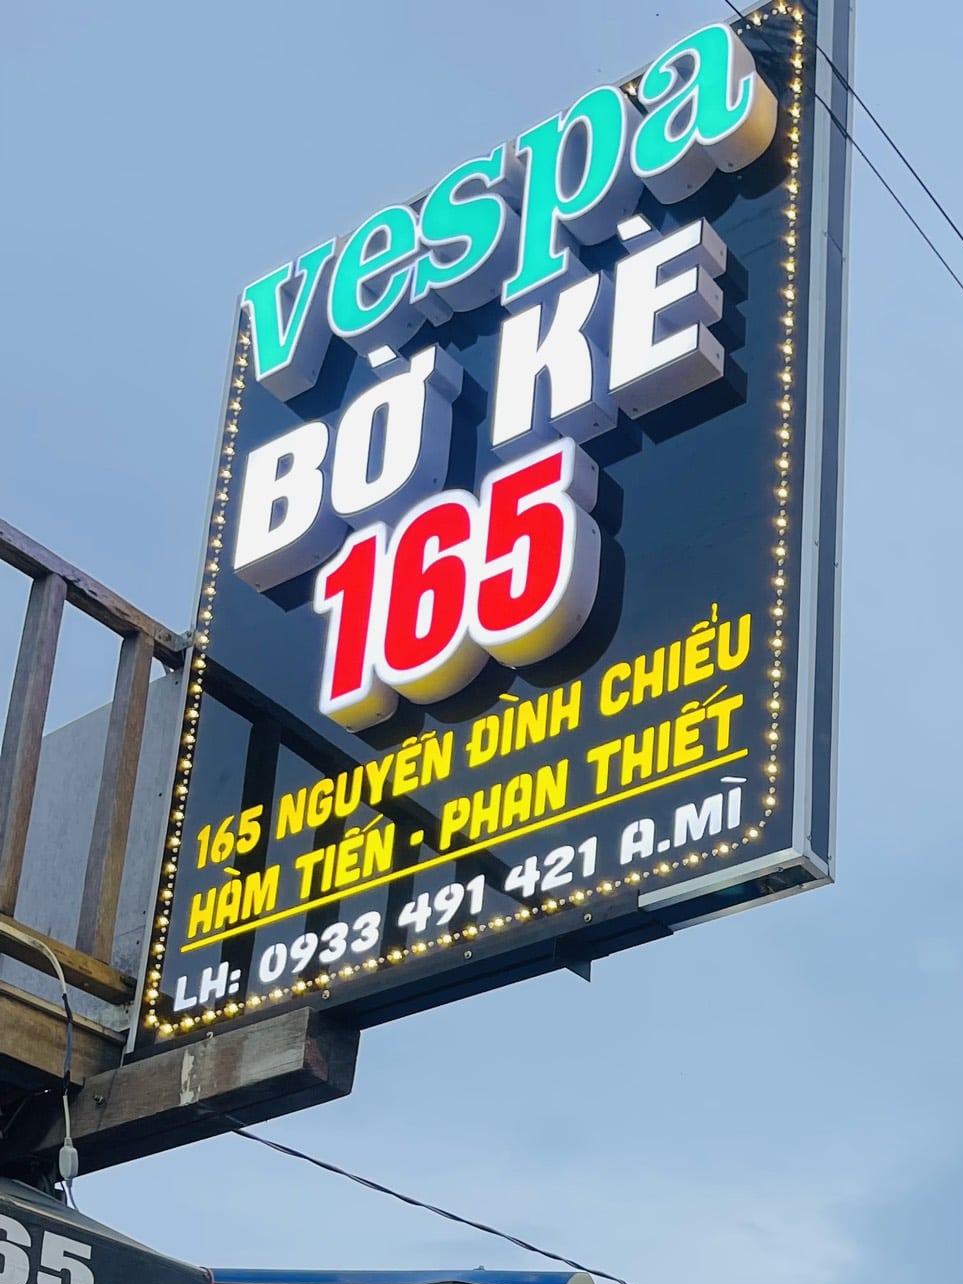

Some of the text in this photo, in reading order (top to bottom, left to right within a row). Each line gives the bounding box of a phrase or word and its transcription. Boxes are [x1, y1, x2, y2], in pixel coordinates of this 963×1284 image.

[233, 214, 705, 573] BỜ KÈ
[315, 439, 575, 715] 165
[186, 866, 281, 939] HÀM
[294, 813, 396, 900] TIẾN
[439, 758, 570, 851] PHAN
[586, 684, 744, 795] THIẾT
[196, 803, 264, 869] 165
[275, 729, 455, 840] NGUYỄN
[465, 679, 583, 768] ĐÌNH
[172, 961, 243, 1012] LH:
[257, 910, 383, 984] 0933
[397, 874, 486, 933] 491
[503, 835, 599, 899] 421
